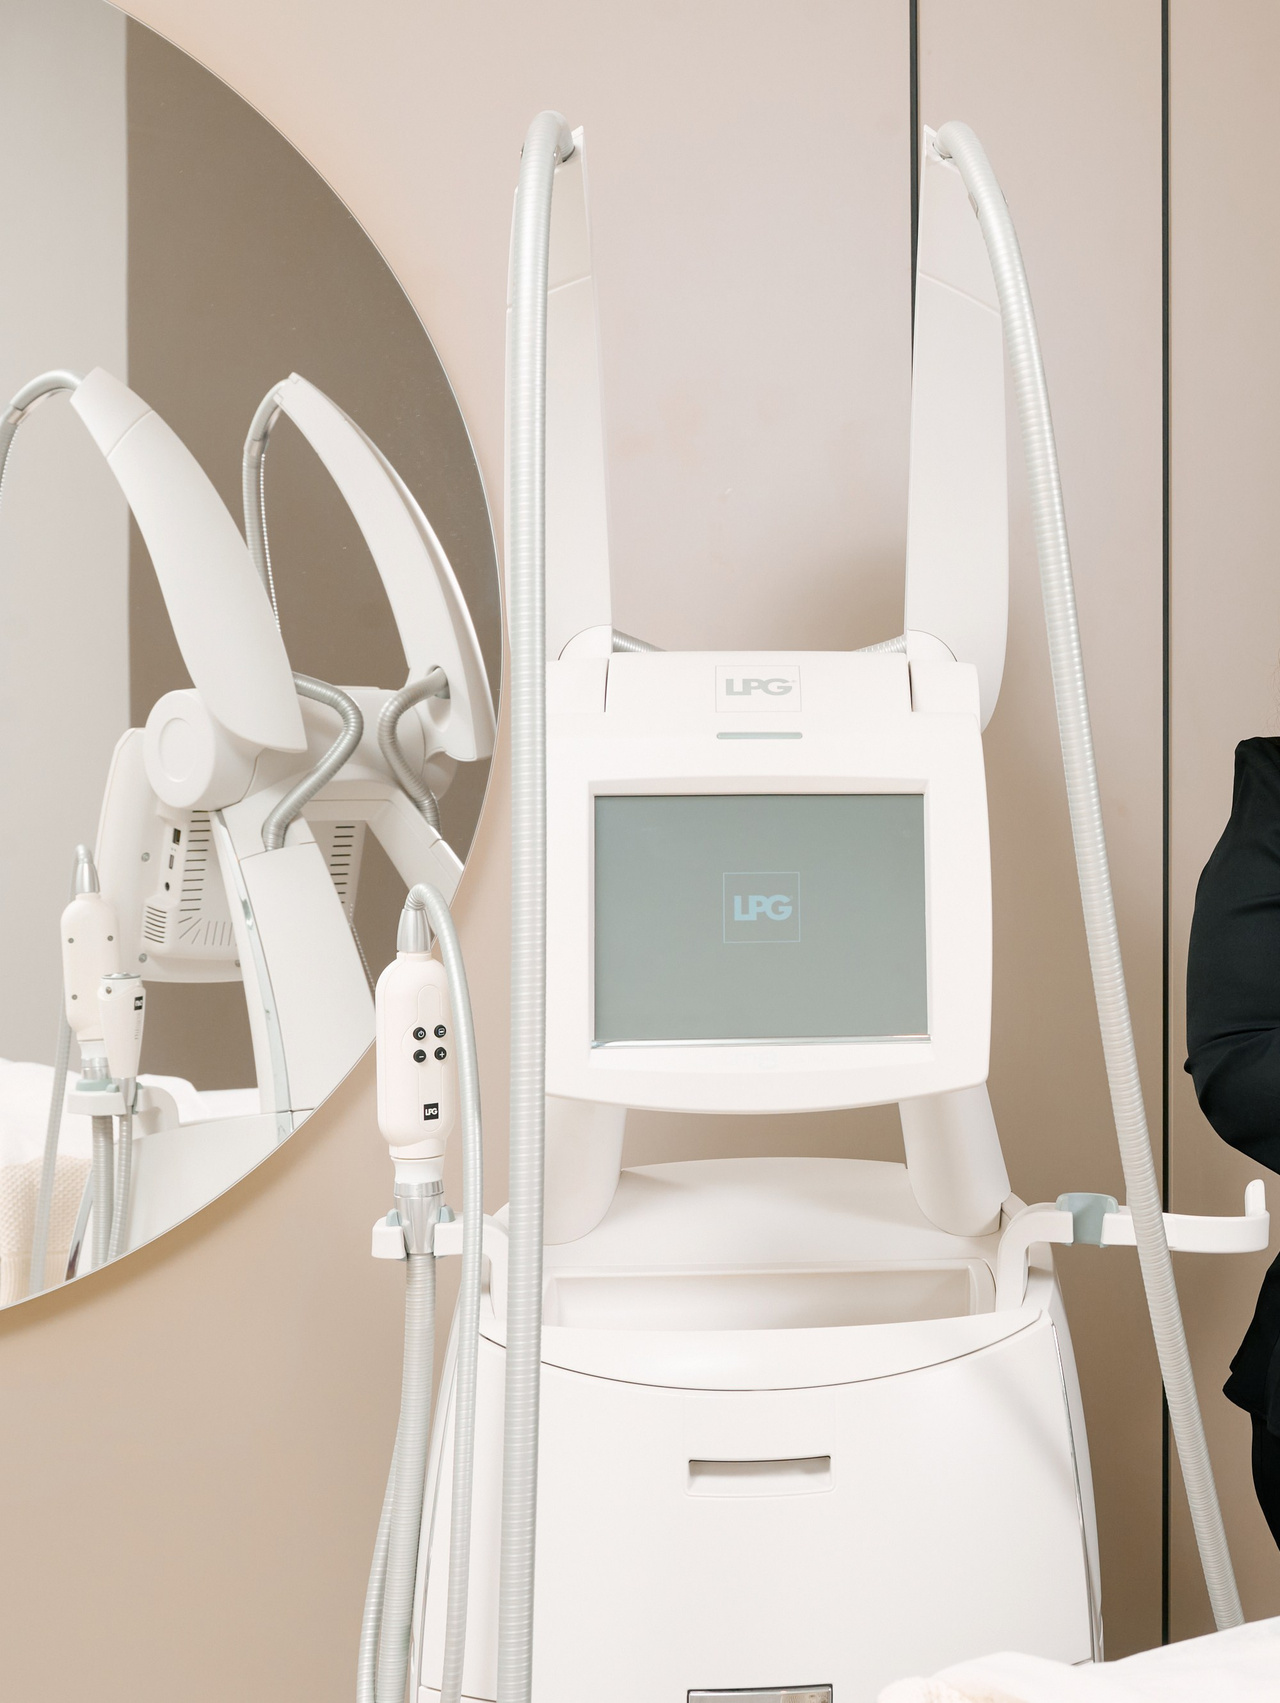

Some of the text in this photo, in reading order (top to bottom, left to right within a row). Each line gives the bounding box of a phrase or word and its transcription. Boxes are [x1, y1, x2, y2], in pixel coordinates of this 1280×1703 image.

[726, 678, 792, 696] LPG
[733, 894, 793, 921] LPG
[425, 1107, 438, 1116] LPG
